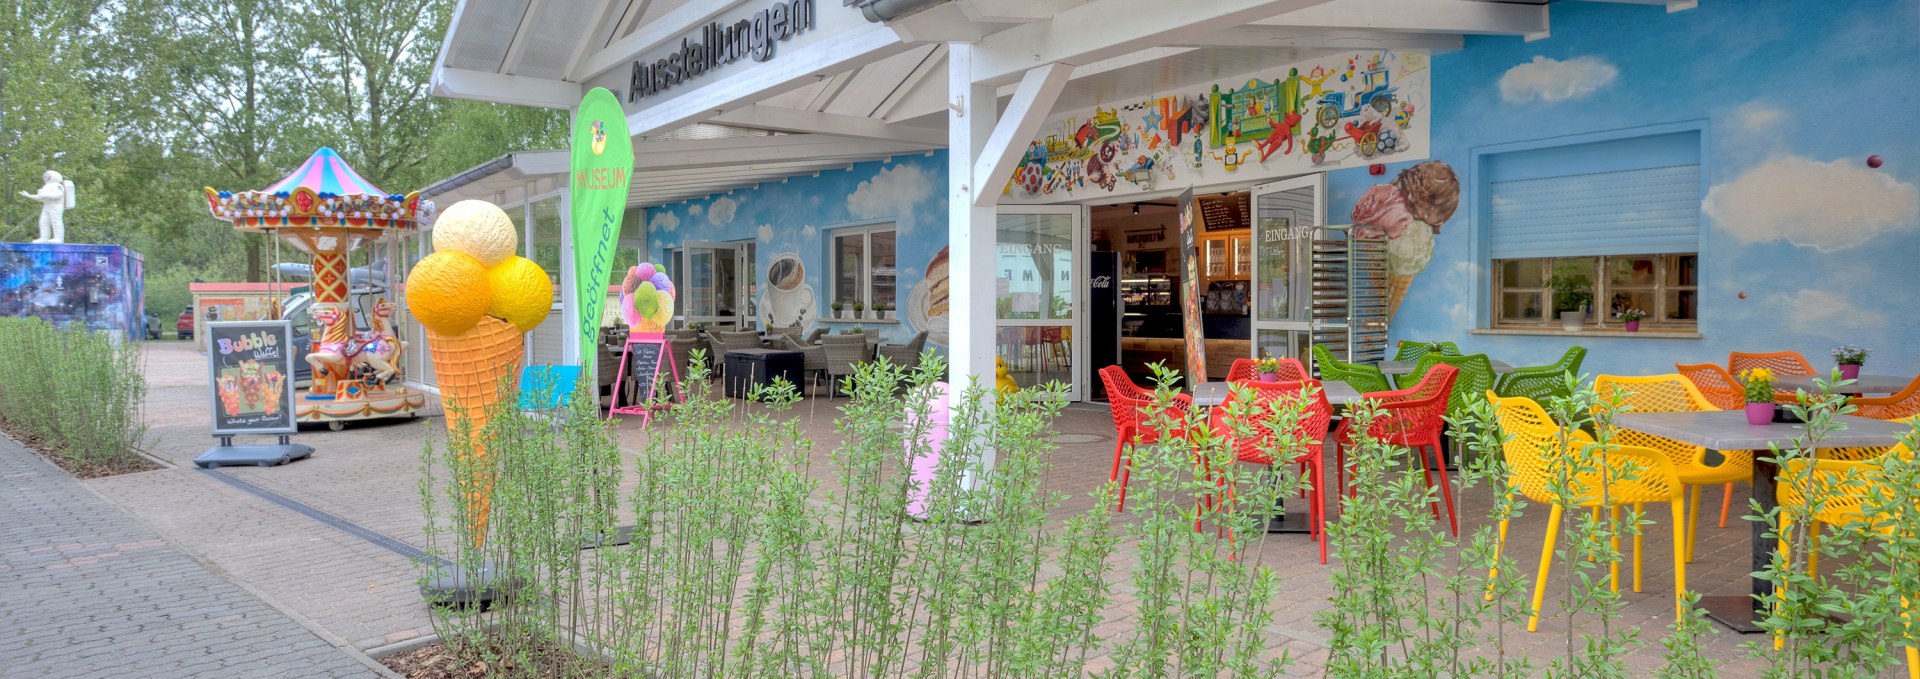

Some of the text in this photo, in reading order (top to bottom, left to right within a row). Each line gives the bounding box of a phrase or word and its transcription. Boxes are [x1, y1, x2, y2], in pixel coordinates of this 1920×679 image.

[628, 0, 814, 103] Ausstellungen
[576, 166, 626, 190] MUSEUM
[1265, 226, 1309, 242] EINGANG
[1000, 243, 1062, 254] EINGANG
[583, 206, 615, 344] geöffnet
[217, 330, 277, 355] Bubble
